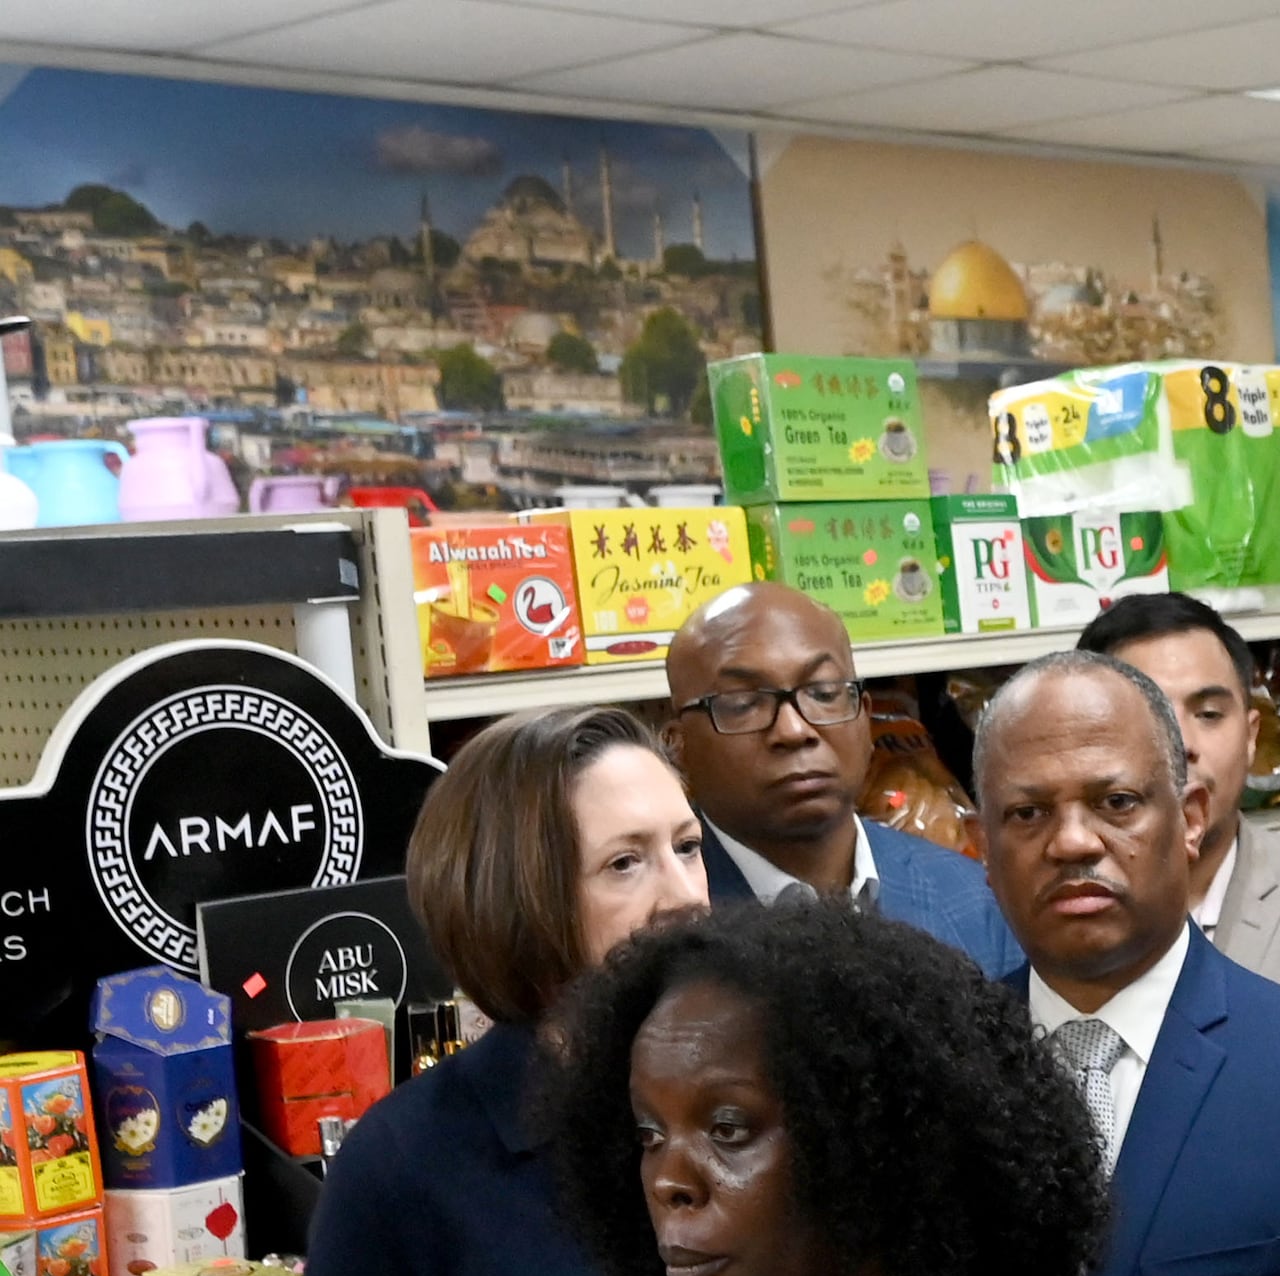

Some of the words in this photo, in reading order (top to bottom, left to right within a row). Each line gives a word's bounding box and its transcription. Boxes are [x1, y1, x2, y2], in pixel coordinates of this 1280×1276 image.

[1200, 366, 1236, 434] 8
[1242, 411, 1268, 425] Rolls
[785, 425, 820, 444] Green
[828, 426, 848, 445] Tea
[429, 538, 512, 563] Alwazah
[970, 537, 1009, 580] PG
[1080, 526, 1119, 570] PG
[591, 565, 683, 606] Jasmine
[685, 566, 720, 594] Tea
[797, 572, 834, 590] Green
[842, 570, 862, 588] Tea
[144, 804, 316, 860] ARMAF
[318, 943, 373, 974] ABU
[315, 968, 379, 1001] MISK
